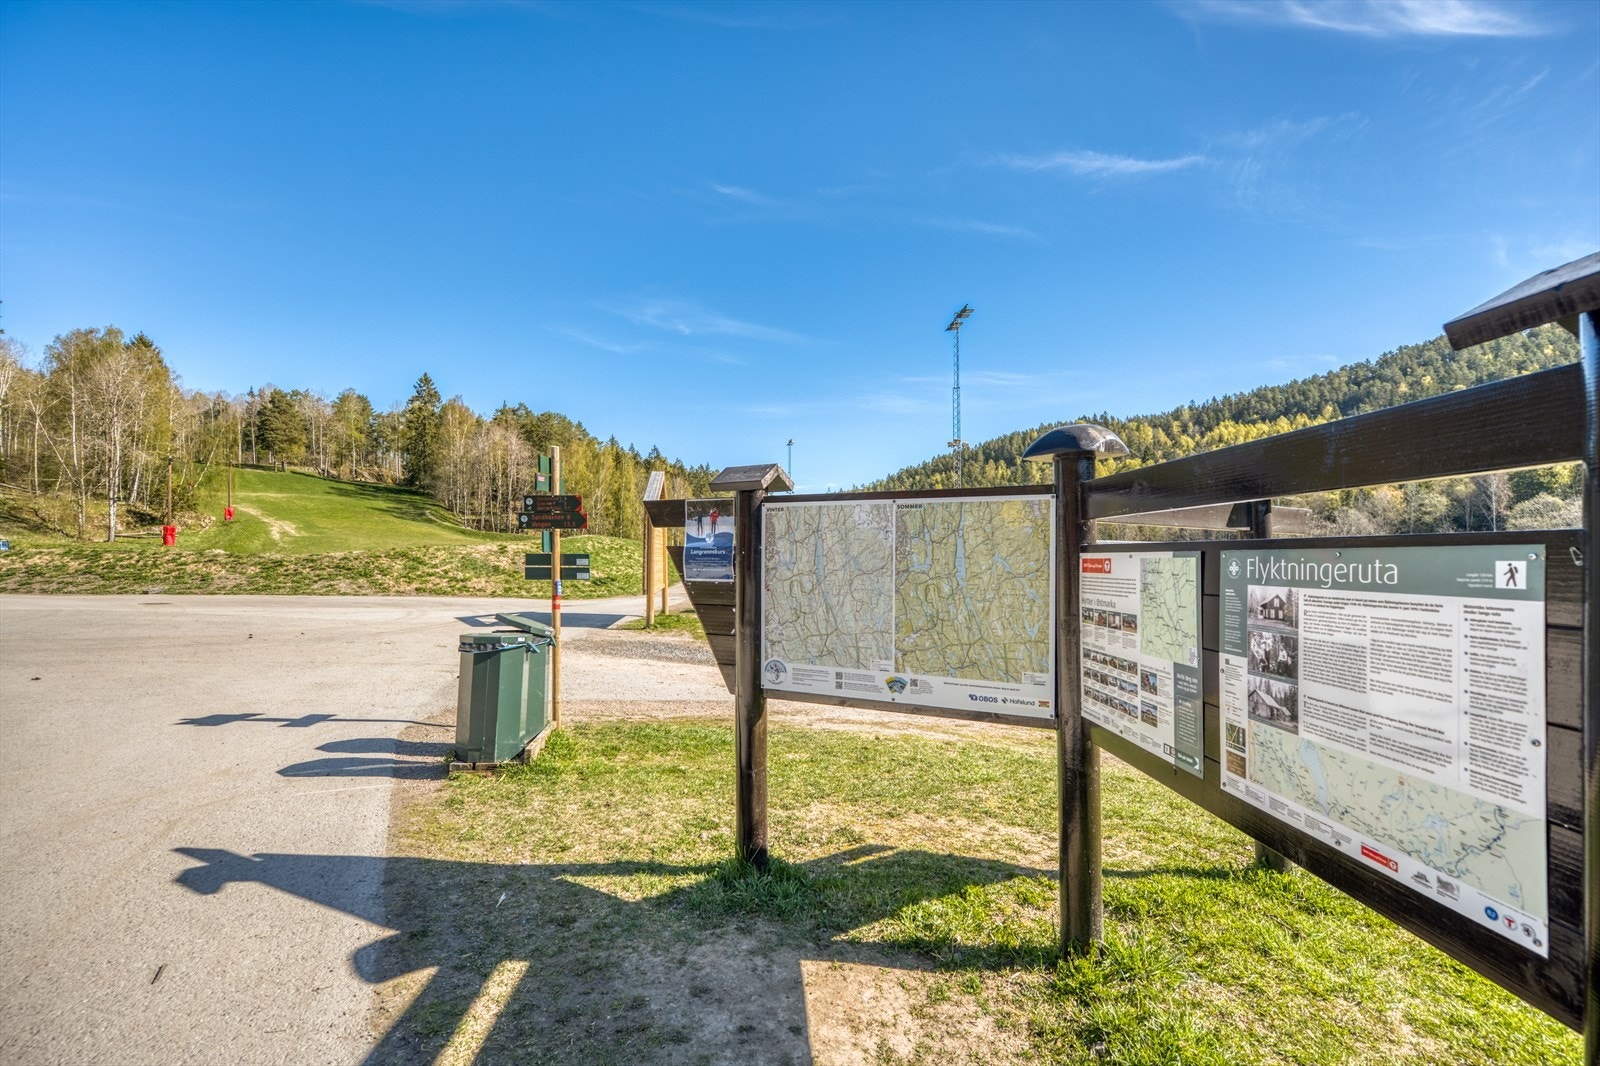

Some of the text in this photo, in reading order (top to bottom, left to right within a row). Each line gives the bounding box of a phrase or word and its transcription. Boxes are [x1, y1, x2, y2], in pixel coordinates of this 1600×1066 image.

[1246, 555, 1398, 588] Flyktningeruta
[978, 695, 999, 703] OBOS
[1009, 698, 1036, 706] Hafslund
